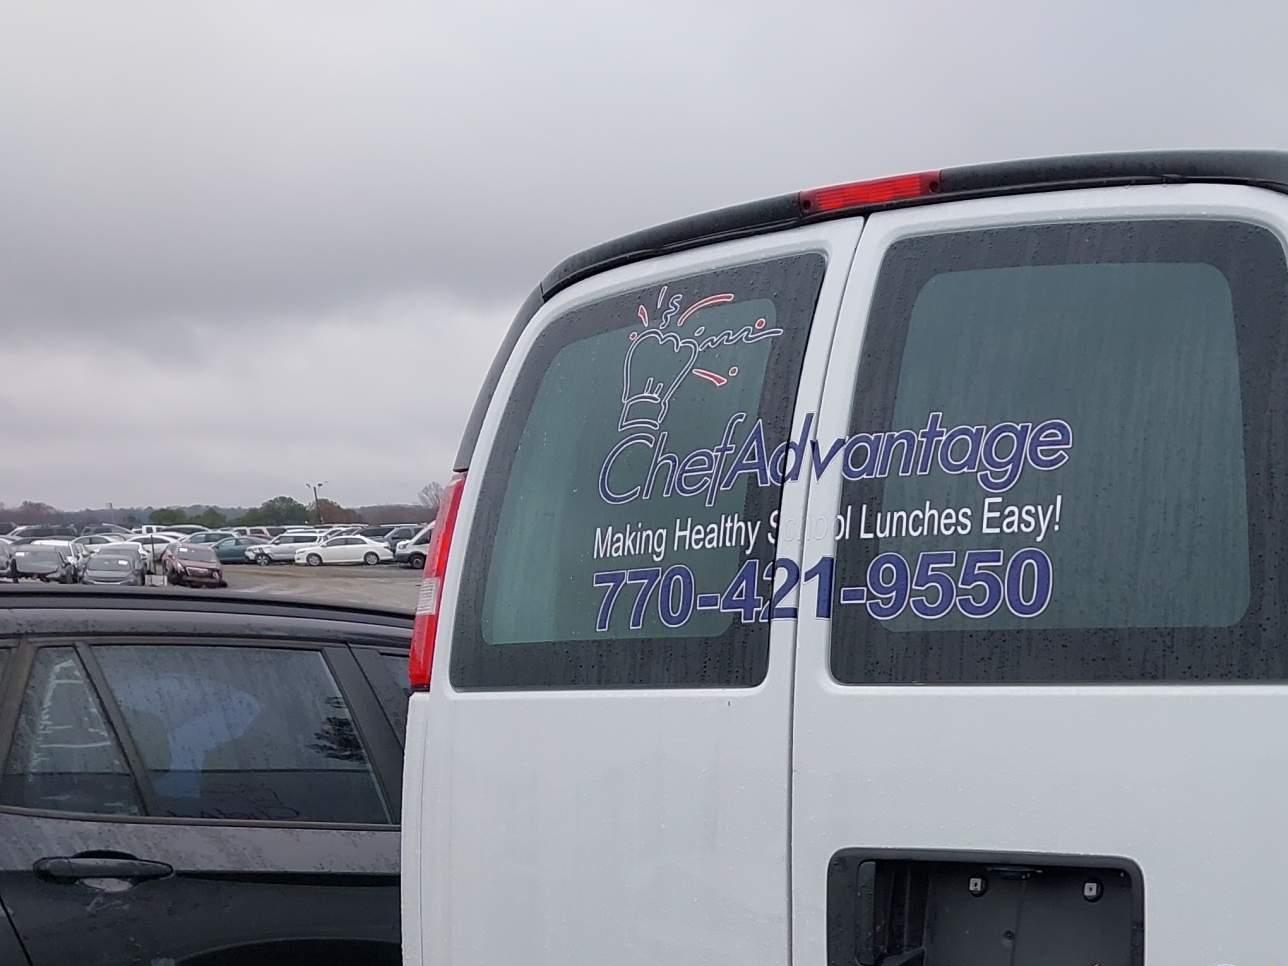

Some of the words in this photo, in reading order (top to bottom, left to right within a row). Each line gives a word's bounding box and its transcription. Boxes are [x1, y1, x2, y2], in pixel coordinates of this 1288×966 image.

[599, 411, 1073, 506] ChefAdvantage
[593, 522, 667, 562] Making
[673, 513, 761, 555] Healthy
[766, 504, 852, 545] Sool
[859, 500, 973, 540] Lunches
[982, 495, 1063, 542] Easy!
[593, 547, 1054, 632] 770-421-9550
